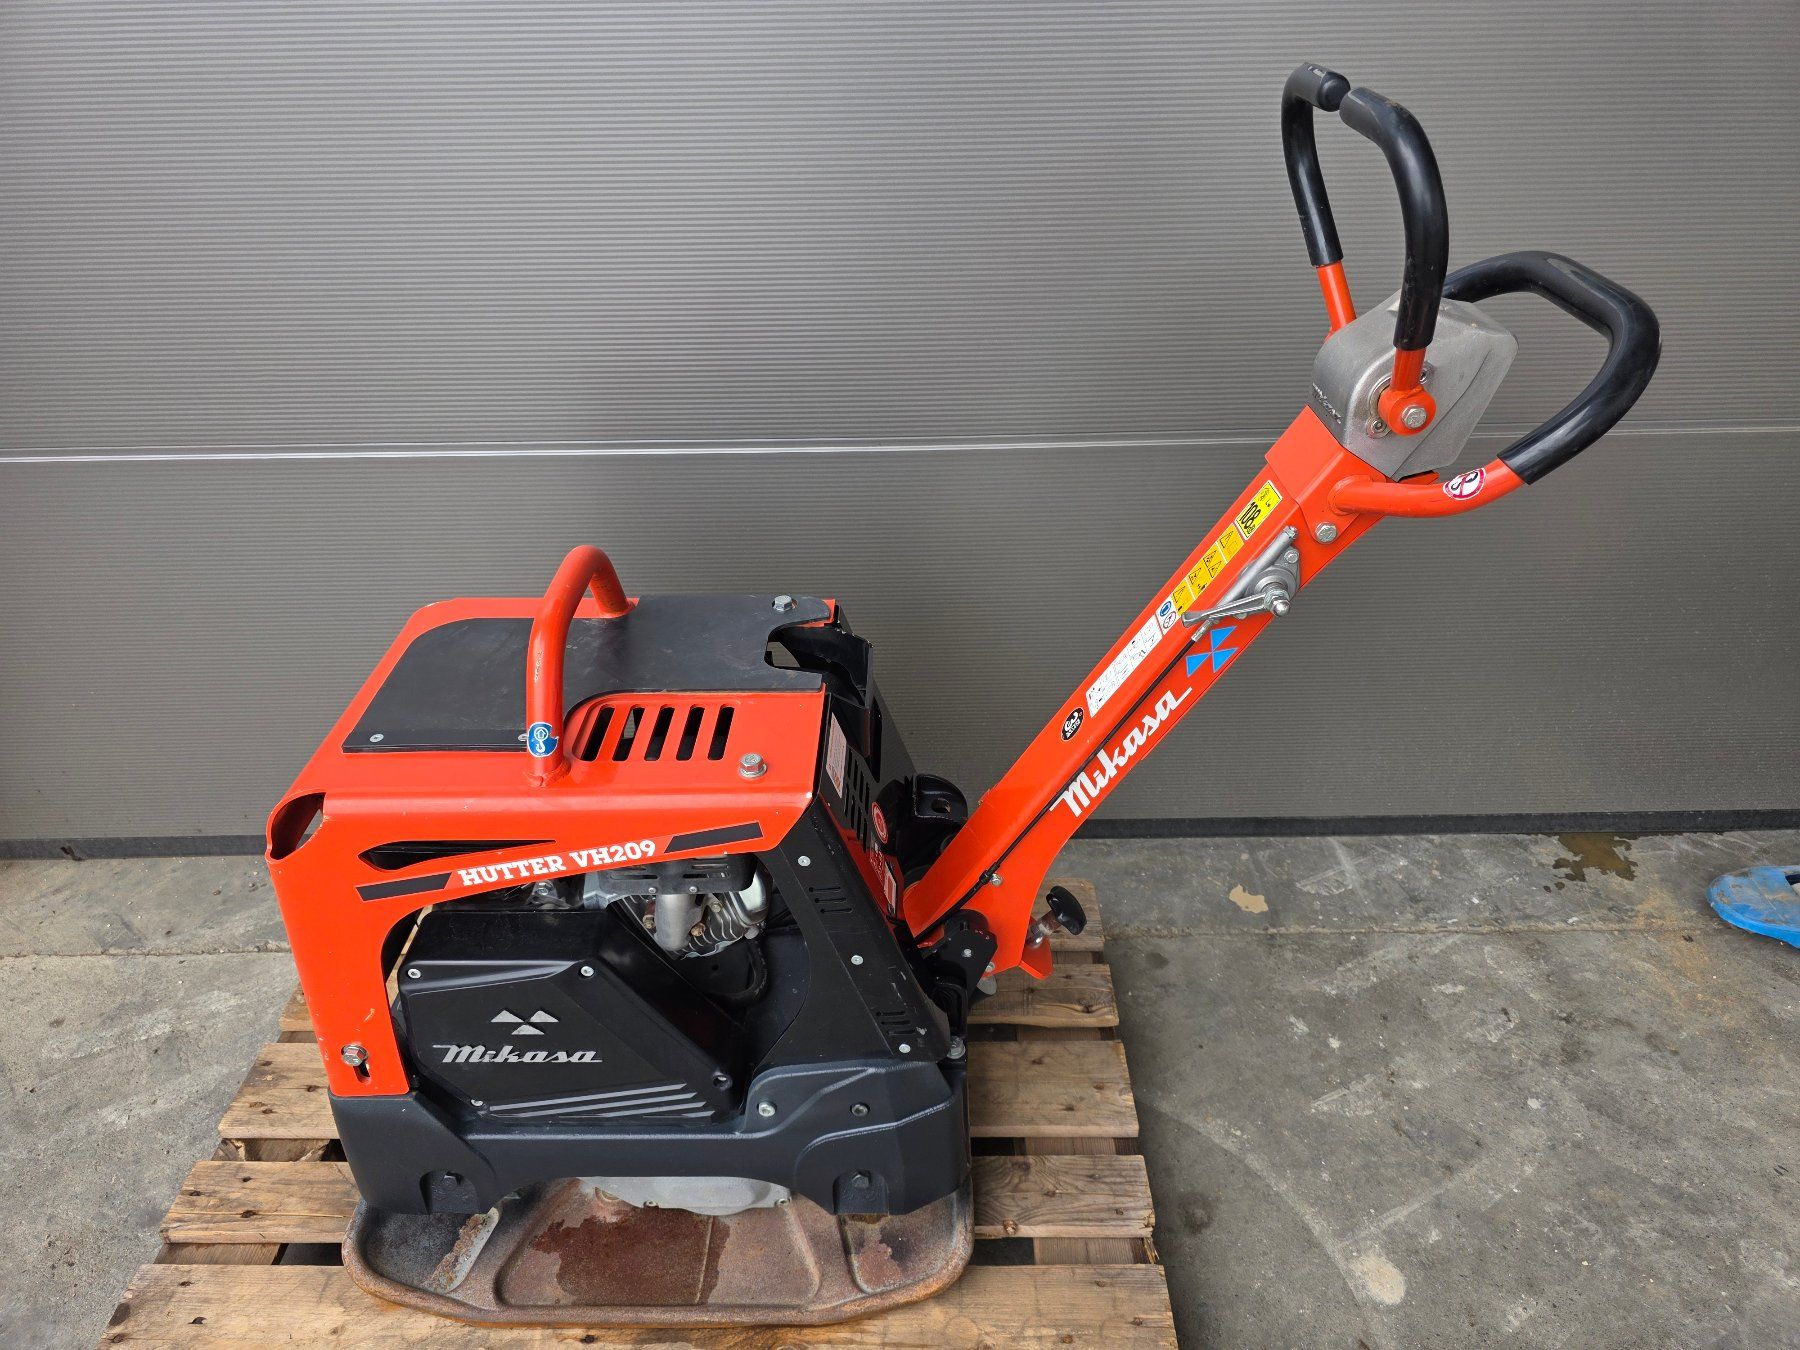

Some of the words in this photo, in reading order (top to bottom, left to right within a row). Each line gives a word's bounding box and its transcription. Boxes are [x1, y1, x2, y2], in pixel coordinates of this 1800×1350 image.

[1239, 501, 1261, 529] 108
[1049, 686, 1193, 818] Mikasa
[457, 855, 566, 886] HUTTER
[568, 839, 656, 868] VH209
[432, 1044, 603, 1063] Mikasa
